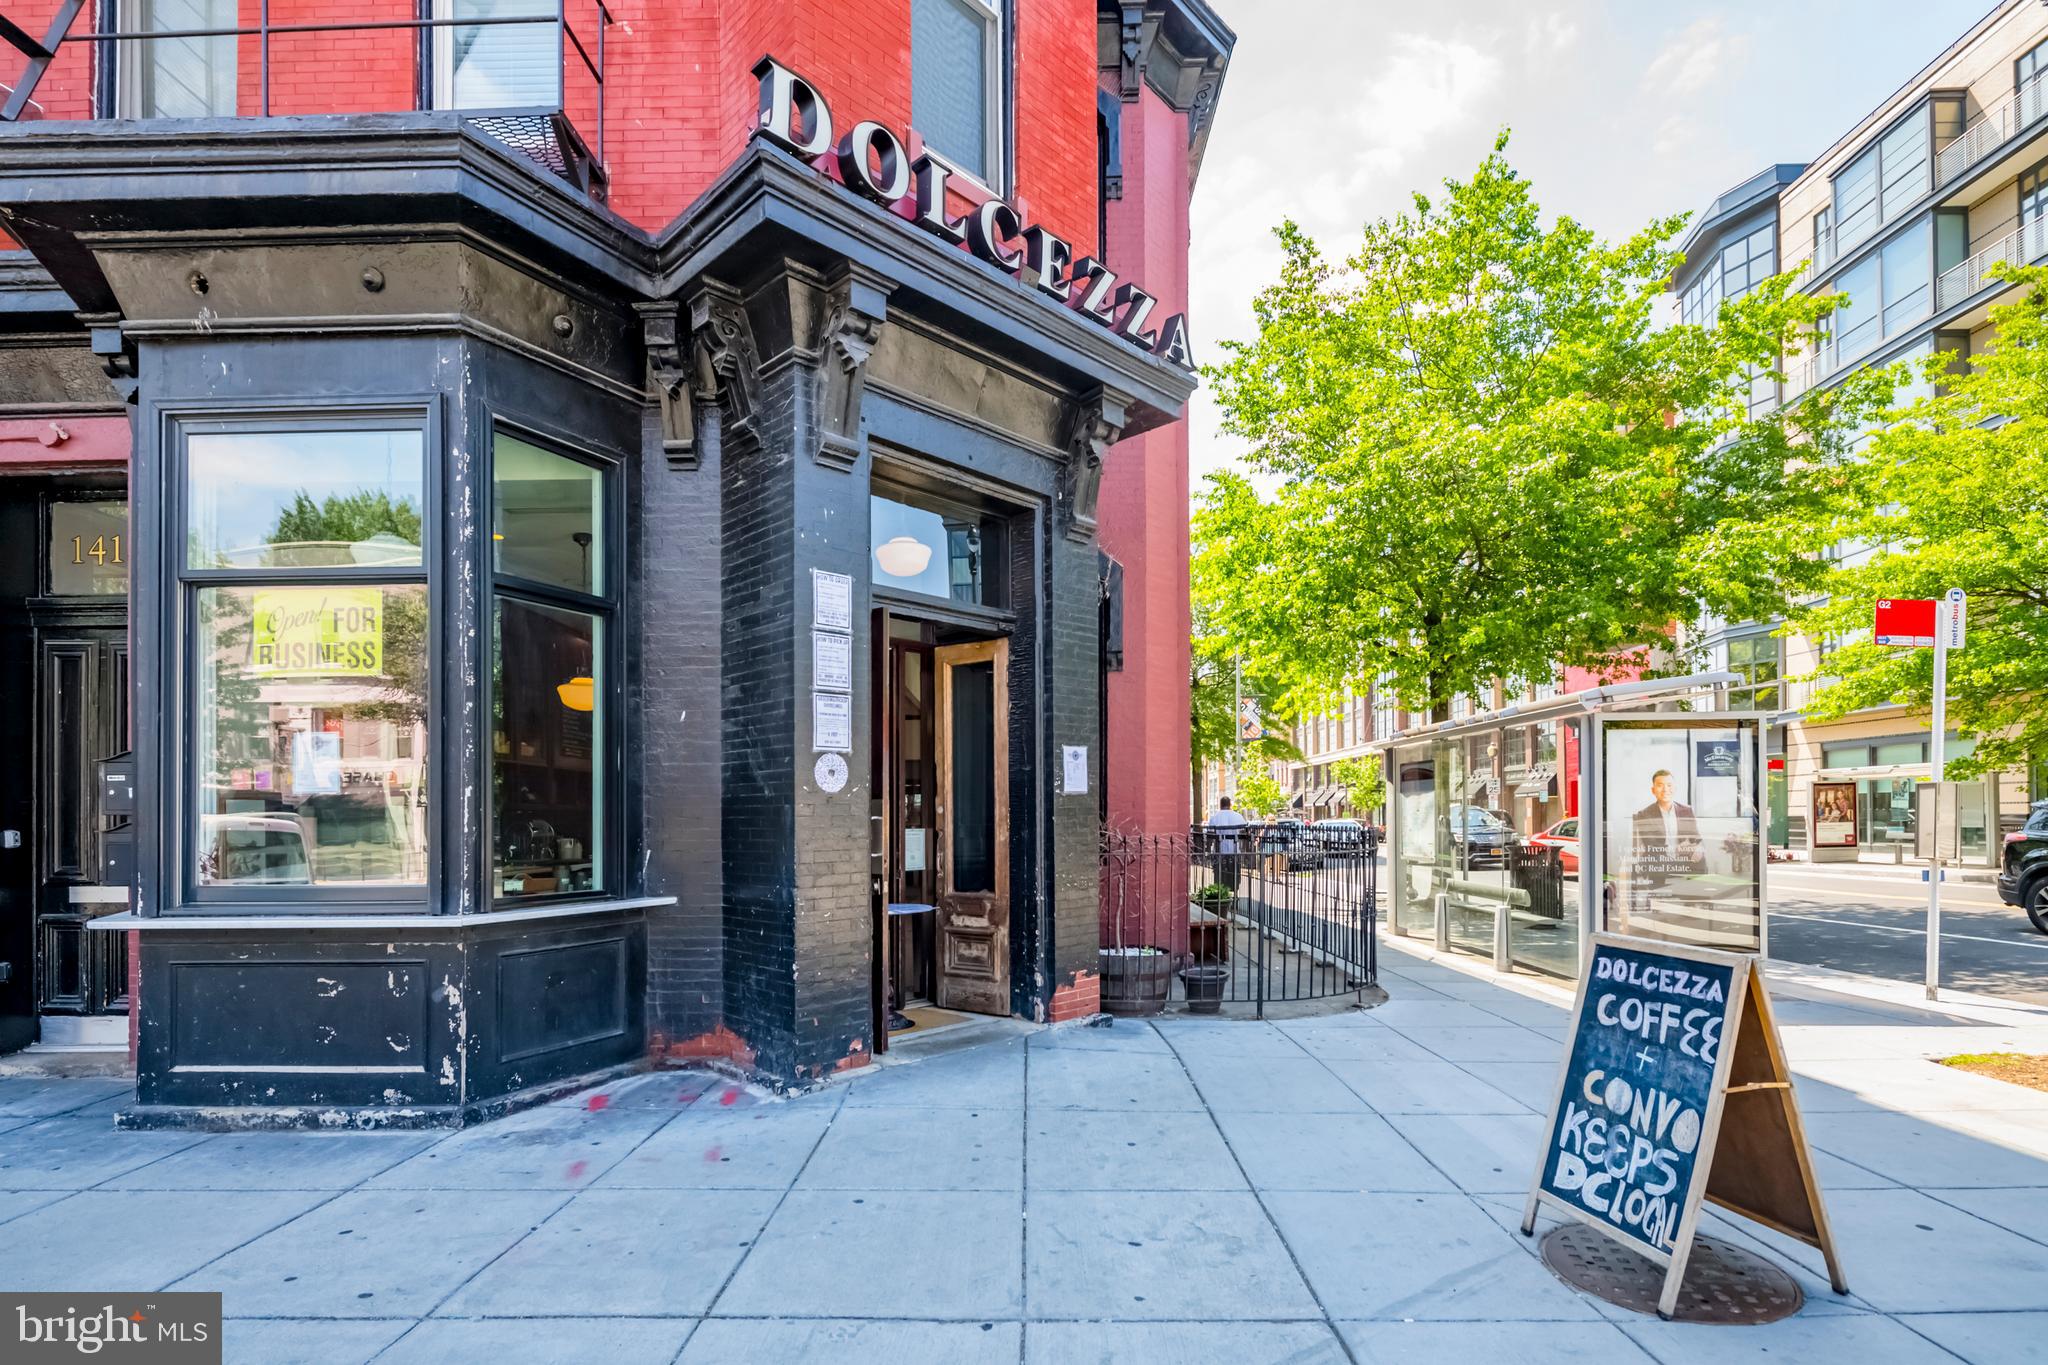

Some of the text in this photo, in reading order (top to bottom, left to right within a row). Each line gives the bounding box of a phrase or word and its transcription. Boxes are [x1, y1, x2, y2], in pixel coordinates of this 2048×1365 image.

[750, 54, 1195, 371] DOLCEZZA
[71, 534, 124, 566] 141
[266, 597, 376, 642] Open! FOR
[1878, 600, 1892, 609] G2
[258, 640, 376, 669] BUSINESS
[1634, 864, 1647, 872] DC
[1648, 864, 1665, 872] Real
[1666, 864, 1692, 872] Estate.
[1596, 956, 1724, 1003] DOLCEZZA
[1596, 993, 1723, 1065] COFFEE
[1583, 1069, 1700, 1154] CONVO
[1559, 1101, 1680, 1196] KEEPS
